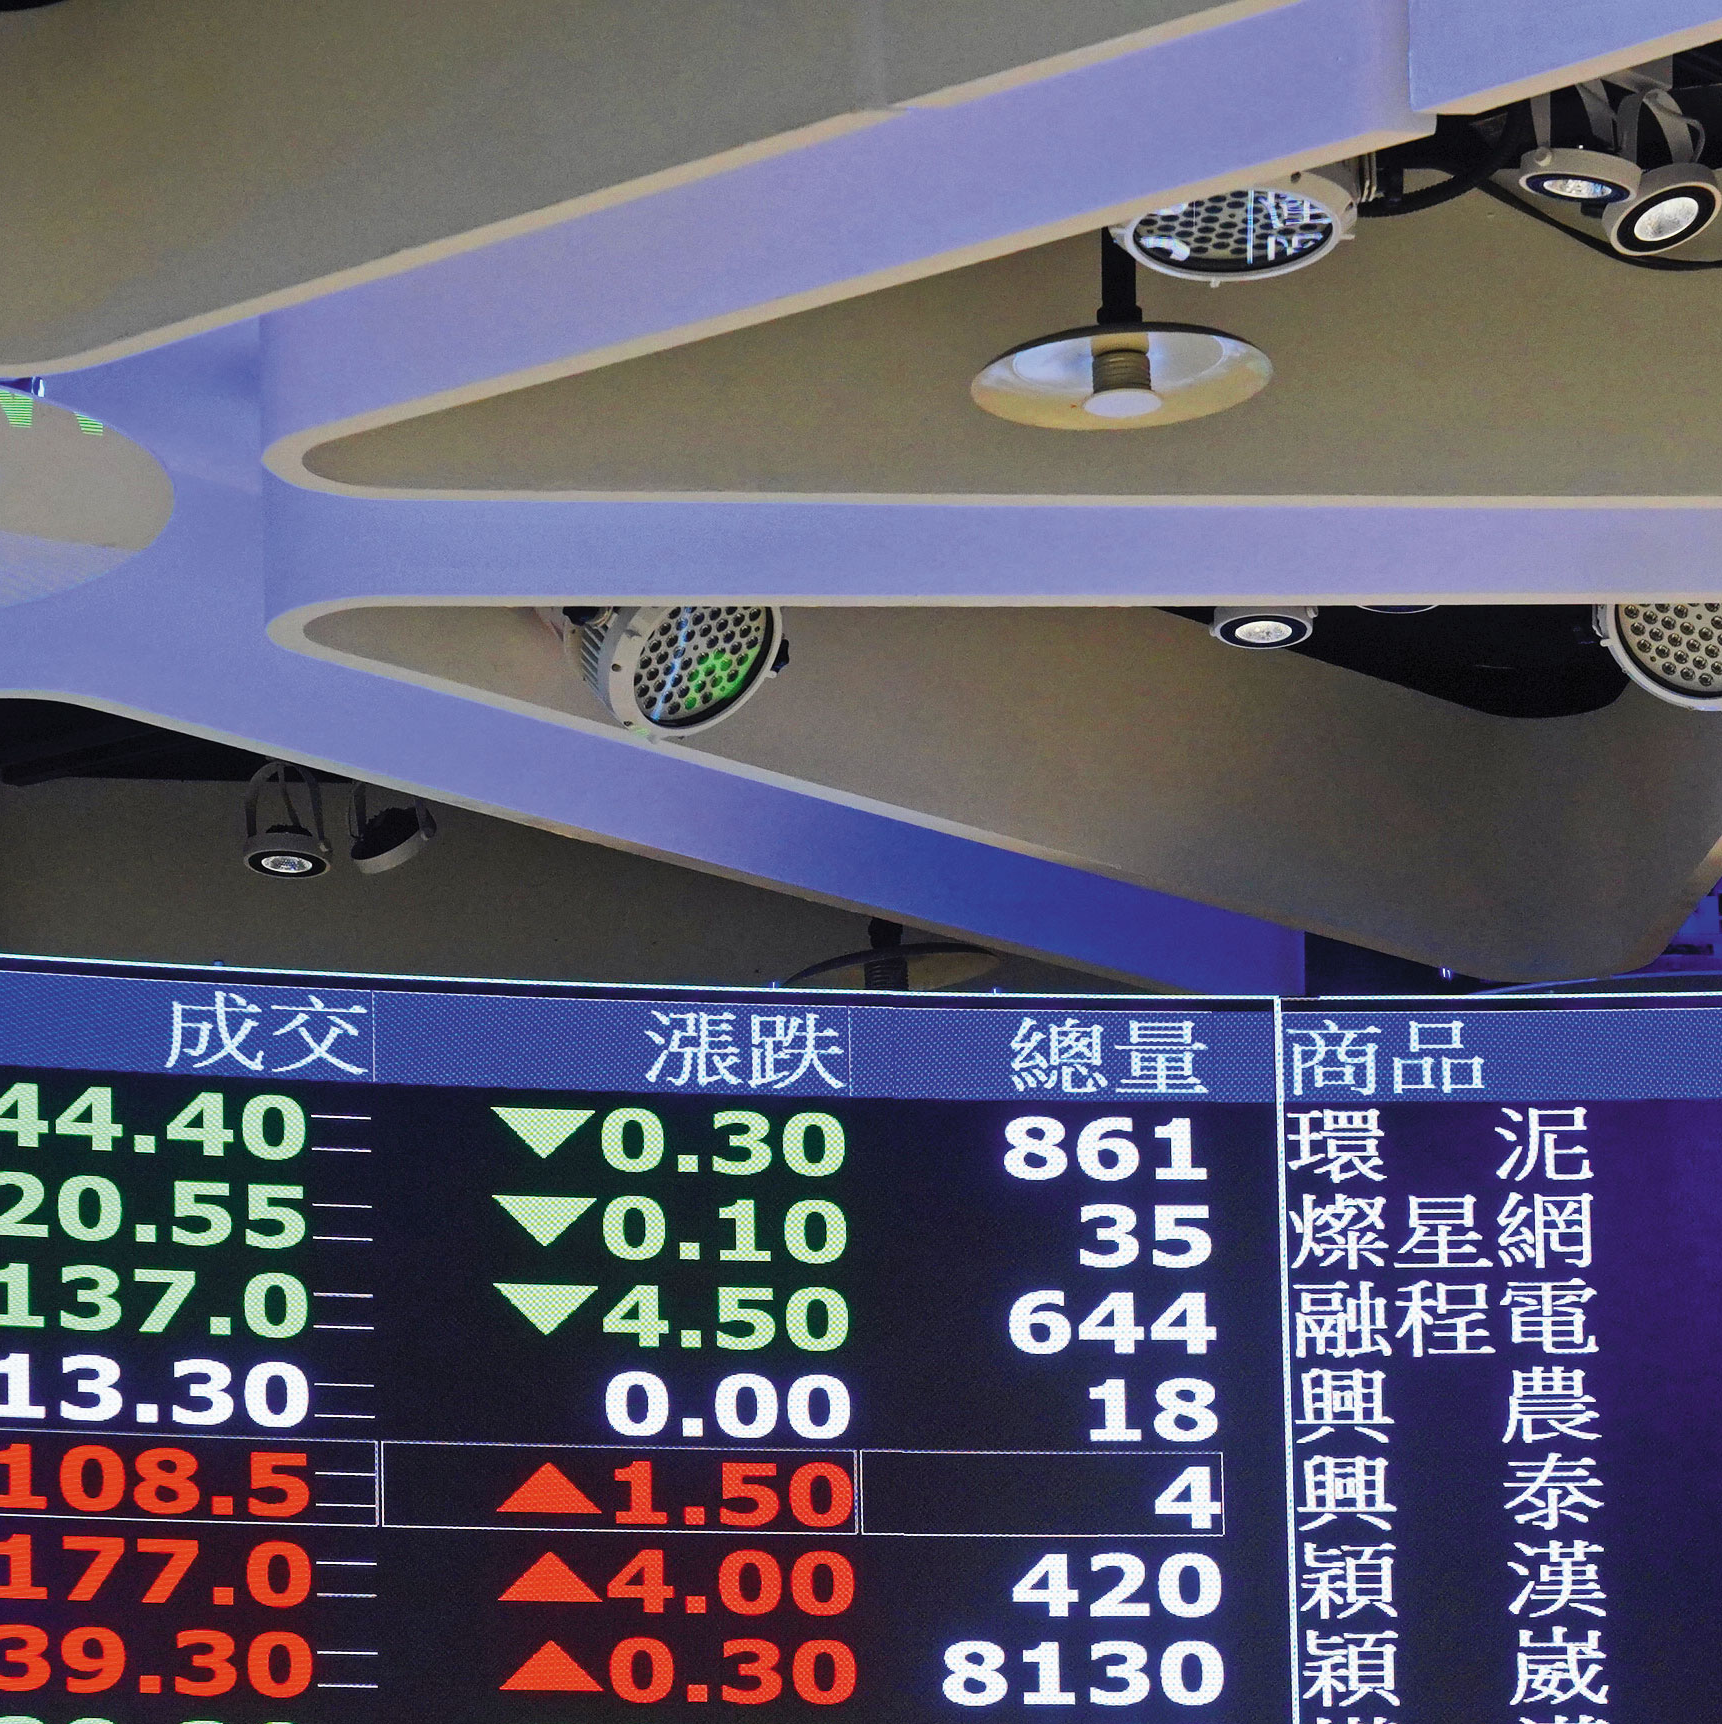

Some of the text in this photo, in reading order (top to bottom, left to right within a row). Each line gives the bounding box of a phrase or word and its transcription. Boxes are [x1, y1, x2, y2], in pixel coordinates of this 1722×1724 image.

[164, 989, 370, 1078] 成交
[643, 1007, 849, 1092] 漲跌
[1006, 1016, 1209, 1099] 總量
[1286, 1018, 1487, 1099] 商品
[600, 1107, 846, 1177] 0.30
[1003, 1115, 1208, 1182] 861
[1288, 1191, 1594, 1270] 燦星網
[602, 1284, 849, 1352] 4.50
[1008, 1289, 1217, 1355] 644
[1292, 1277, 1600, 1359] 融程電
[603, 1371, 852, 1440] 0.00
[1088, 1377, 1219, 1442] 18
[606, 1548, 856, 1617] 4.00
[1012, 1552, 1222, 1618] 420
